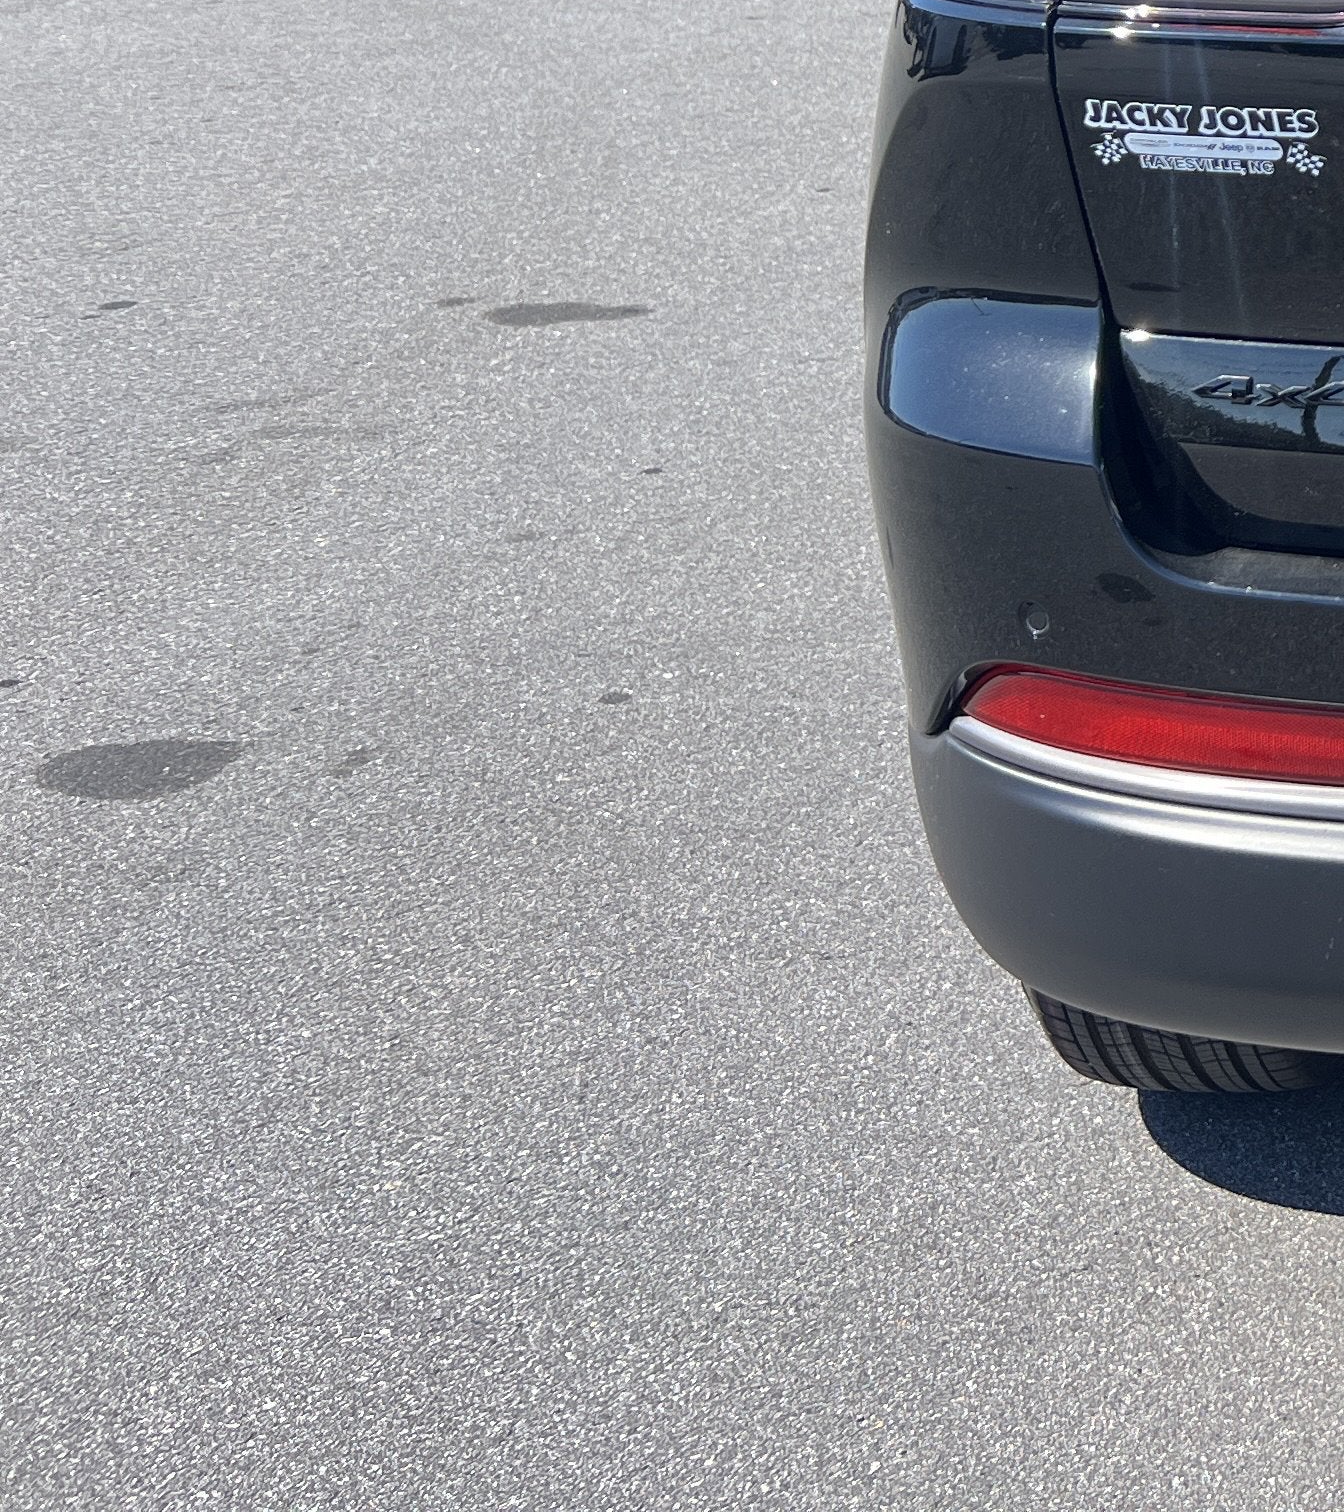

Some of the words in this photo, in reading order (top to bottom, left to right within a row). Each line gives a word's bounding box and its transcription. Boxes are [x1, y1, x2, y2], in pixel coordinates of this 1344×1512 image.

[1084, 98, 1192, 133] JACKY
[1198, 106, 1319, 138] JONES
[1219, 142, 1244, 153] Jeep
[1139, 154, 1247, 176] HAYESVILLE,
[1248, 160, 1275, 175] NC
